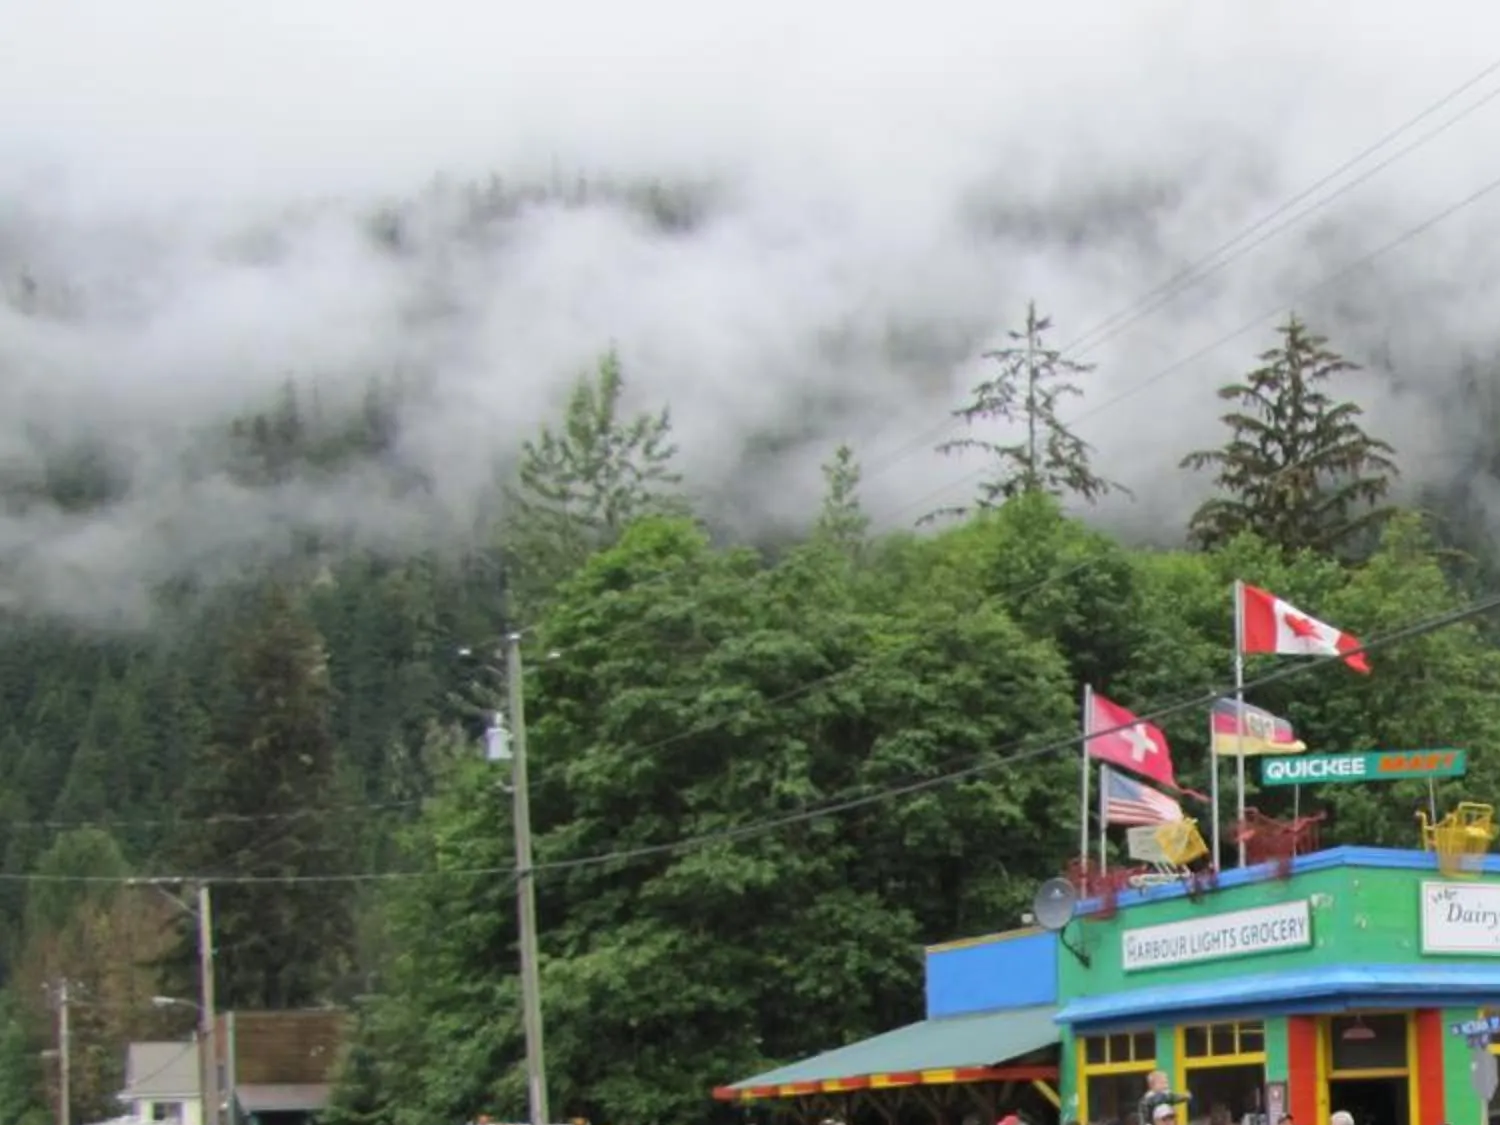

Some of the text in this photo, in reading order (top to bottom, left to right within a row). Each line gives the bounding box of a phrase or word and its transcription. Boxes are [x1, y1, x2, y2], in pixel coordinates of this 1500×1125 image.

[1266, 756, 1366, 779] QUICKEE
[1446, 902, 1500, 929] Dairy
[1126, 916, 1306, 961] HARBOUR LIGHTS GROCERY
